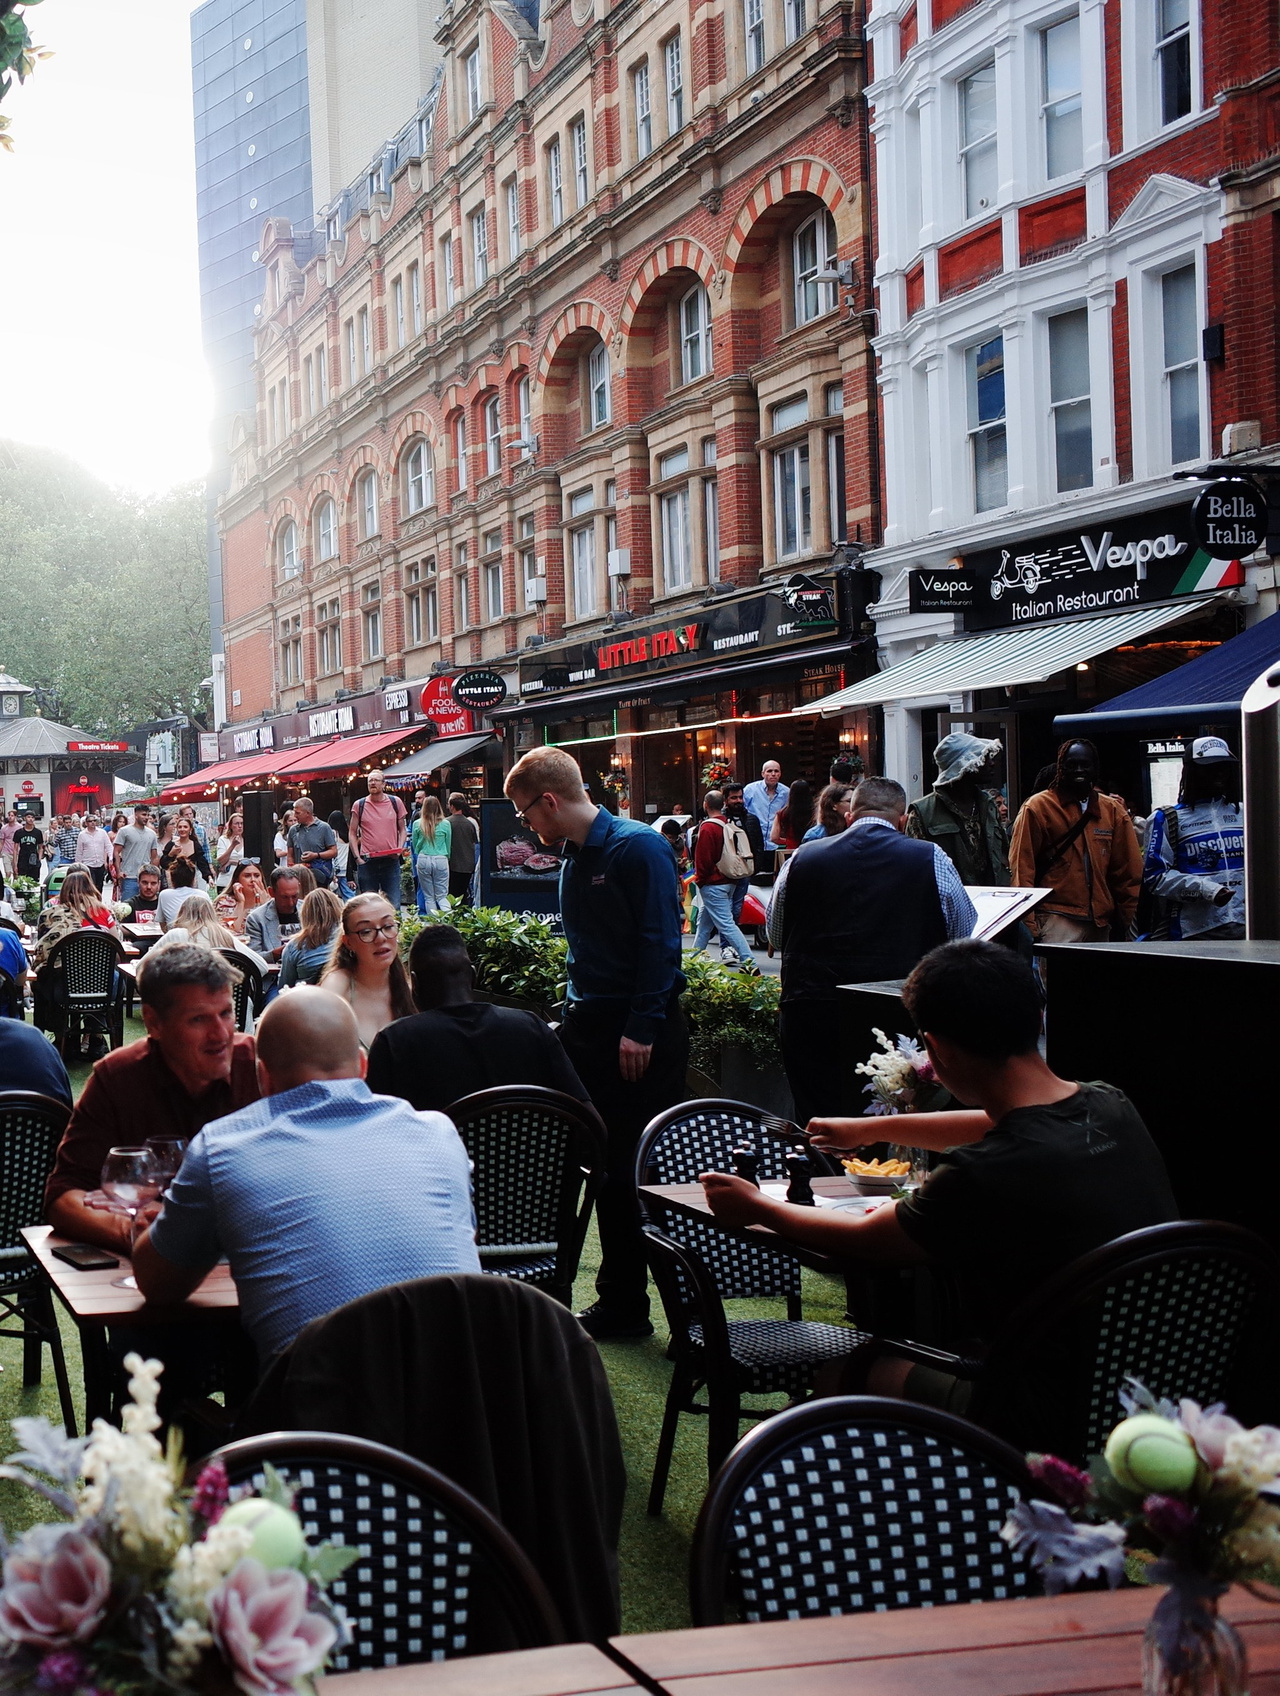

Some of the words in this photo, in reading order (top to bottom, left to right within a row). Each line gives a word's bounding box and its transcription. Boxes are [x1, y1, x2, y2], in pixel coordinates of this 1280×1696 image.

[1207, 496, 1257, 518] Bella
[1207, 523, 1258, 545] Italia
[1080, 531, 1189, 580] Vespa
[919, 575, 973, 594] Vespa
[802, 593, 822, 601] STEAK
[920, 599, 938, 607] Italian
[1011, 602, 1054, 621] Italian
[1056, 582, 1140, 612] Restaurant
[777, 621, 802, 637] STE
[713, 630, 760, 651] RESTAURANT
[598, 637, 647, 671] LITTLE
[461, 673, 499, 686] PIZZERIA
[584, 668, 596, 679] BAR
[804, 667, 824, 678] STEAK
[458, 687, 482, 695] LITTLE
[521, 679, 544, 693] PIZZERIA
[385, 689, 409, 711] ESPRESSO
[461, 693, 502, 708] RESTAURANT
[400, 710, 410, 724] BAR
[428, 707, 435, 715] &
[435, 706, 462, 715] NEWS
[308, 709, 338, 738] RISTORANTE
[338, 705, 354, 733] ROMA
[447, 717, 466, 733] NEWS
[77, 743, 99, 751] Theatre
[99, 743, 119, 751] Tickets
[233, 729, 260, 754] RISTORANTE
[260, 725, 274, 748] ROMA
[1147, 742, 1165, 754] Bella
[1165, 741, 1185, 752] Italia
[913, 773, 919, 784] 9
